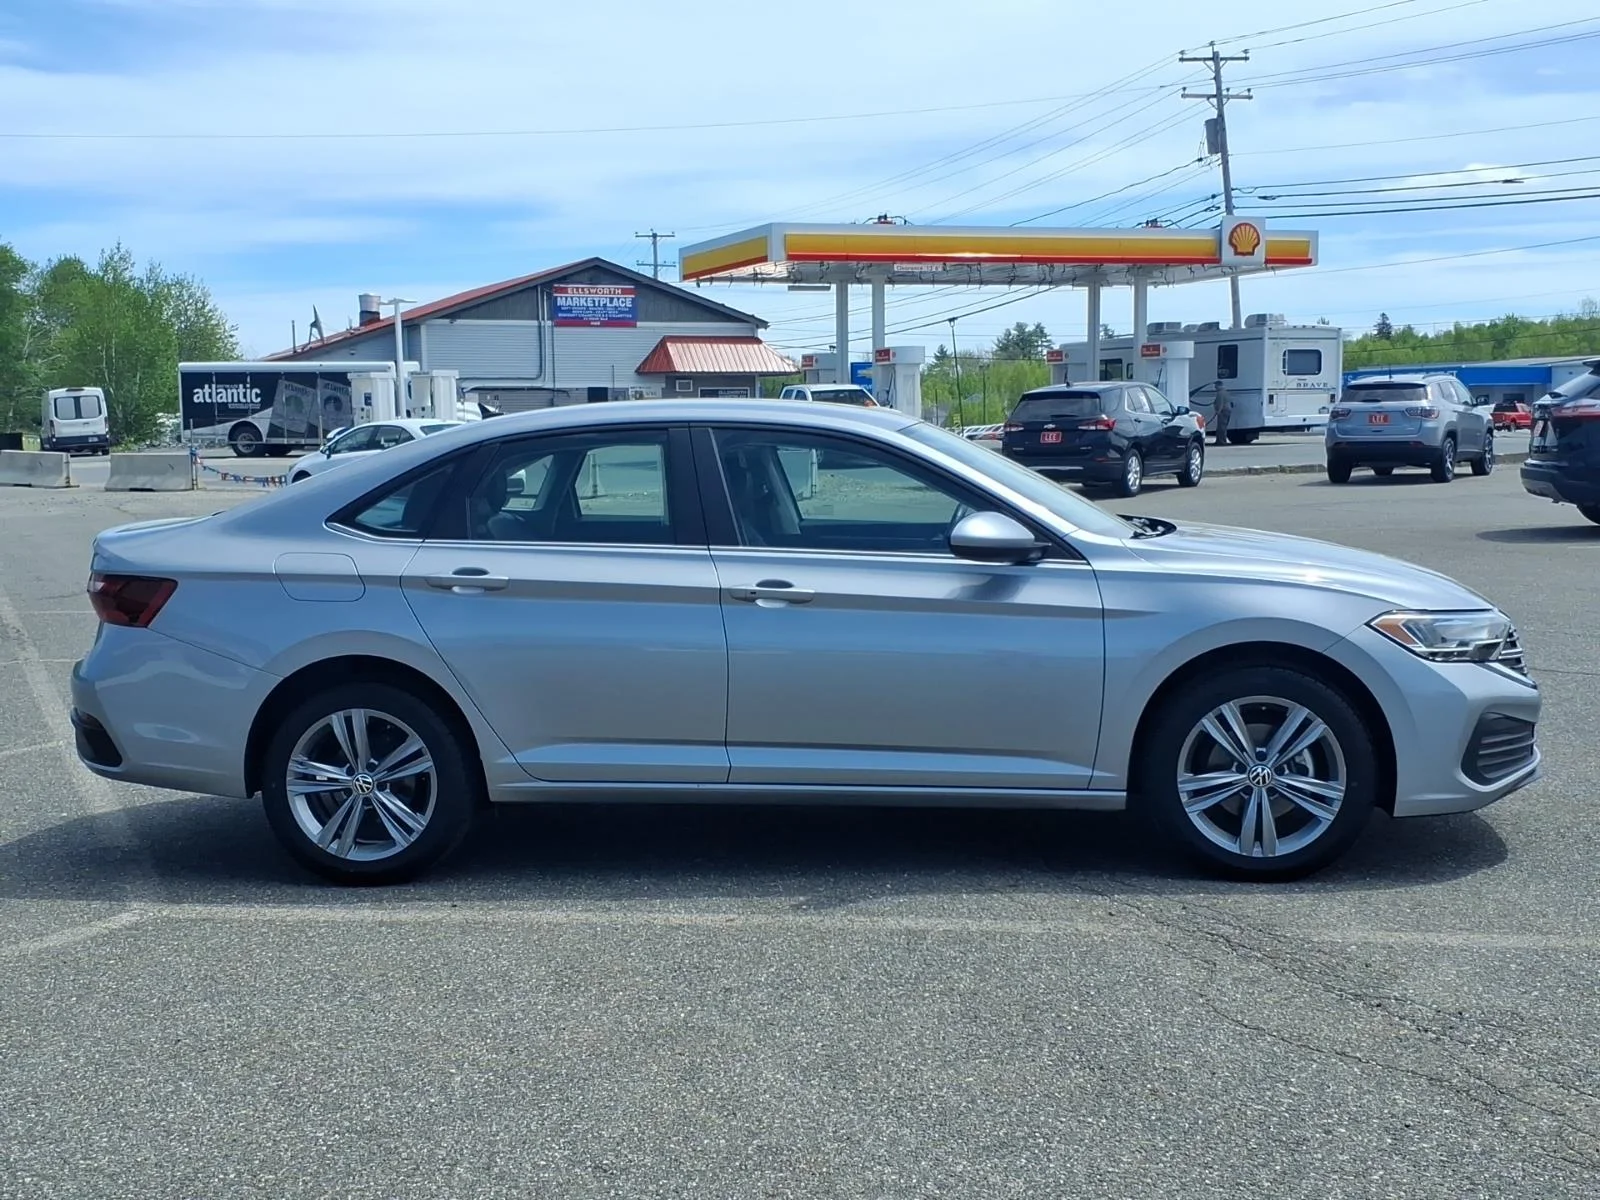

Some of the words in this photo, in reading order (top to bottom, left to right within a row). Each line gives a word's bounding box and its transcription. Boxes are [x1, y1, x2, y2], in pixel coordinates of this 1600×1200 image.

[567, 287, 622, 295] ELLSWORTH
[556, 296, 633, 307] MARKETPLACE
[193, 384, 262, 404] atlantic
[1372, 415, 1385, 423] LEE
[1044, 433, 1058, 441] LEE
